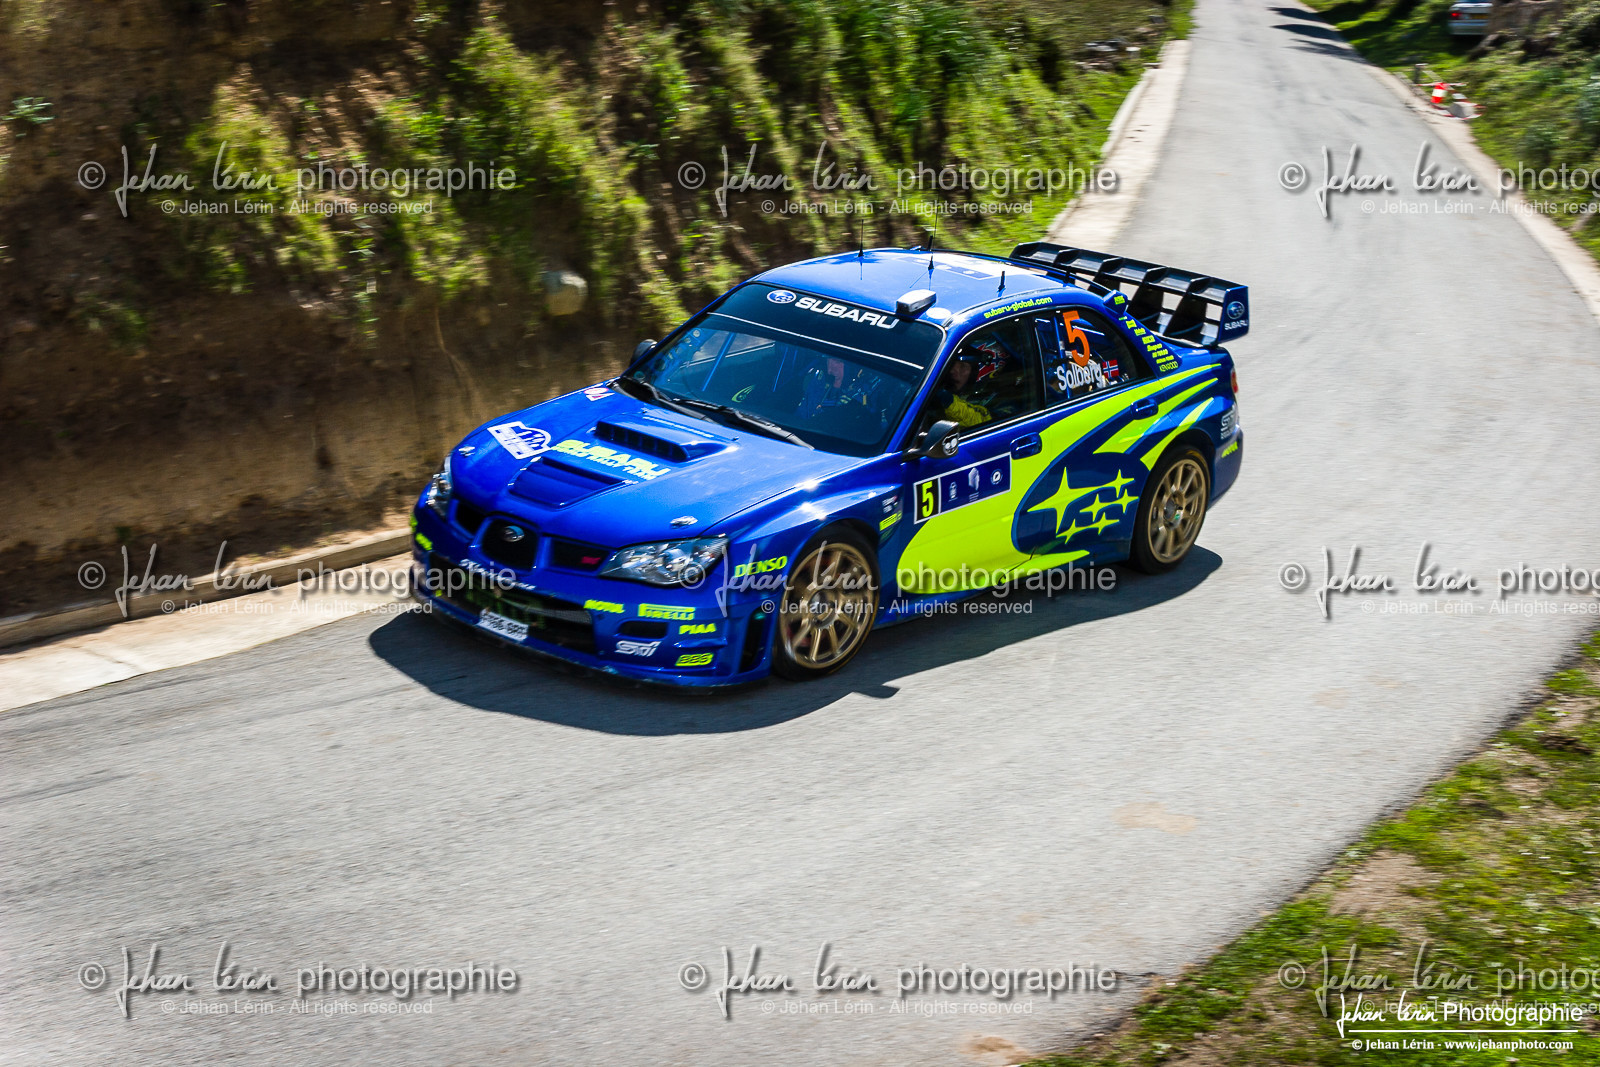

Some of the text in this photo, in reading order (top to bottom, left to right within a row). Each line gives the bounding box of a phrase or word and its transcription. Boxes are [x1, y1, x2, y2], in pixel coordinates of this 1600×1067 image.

[795, 297, 900, 329] SUBARU
[984, 297, 1052, 319] subaru-global.com
[1062, 310, 1091, 367] 5
[1056, 362, 1105, 391] Solberg
[921, 480, 934, 518] 5
[734, 555, 788, 578] DENSO
[638, 602, 696, 621] PIRELLI
[679, 623, 717, 635] PIAA
